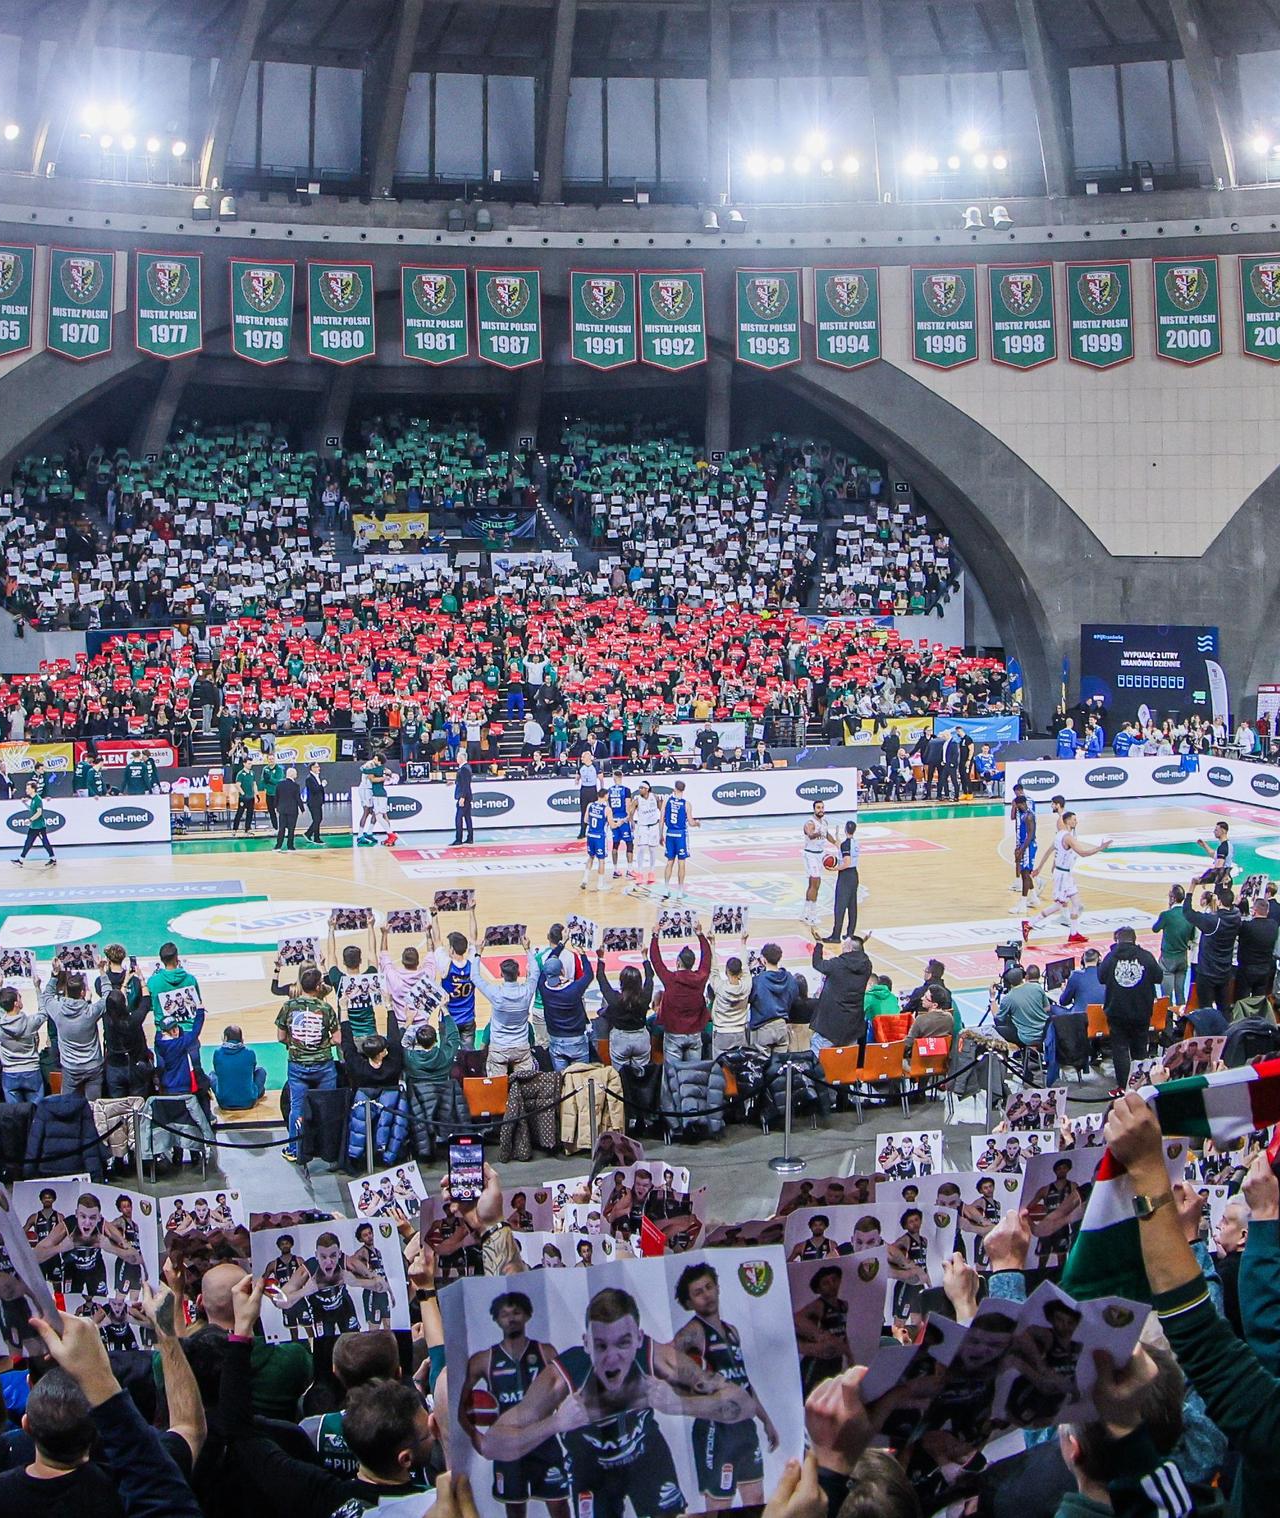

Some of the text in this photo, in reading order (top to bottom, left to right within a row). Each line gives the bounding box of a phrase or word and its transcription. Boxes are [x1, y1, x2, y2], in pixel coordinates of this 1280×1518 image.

[0, 305, 28, 315] POLSKI
[53, 307, 109, 319] MISTRZ POLSKI
[140, 309, 197, 319] MISTRZ POLSKI
[236, 315, 289, 326] MISTRZ POLSK
[313, 316, 371, 325] MISTRZ POLSKI
[1160, 315, 1216, 324] MISTRZ POLSKI
[1247, 313, 1274, 321] MISTRZ
[407, 319, 464, 328] MISTRZ POLSKI
[482, 322, 537, 331] MISTRZ POLSKI
[576, 323, 632, 333] MISTRZ POLSKI
[645, 325, 701, 333] MISTRZ POLSKI
[741, 323, 797, 332] MISTRZ POLSKI
[820, 321, 876, 330] MISTRZ POLSKI
[917, 321, 973, 330] MISTRZ POLSKI
[995, 320, 1051, 330] MISTRZ POLSKI
[1073, 319, 1129, 328] MISTRZ POLSKI
[60, 324, 99, 343] 1970
[150, 325, 187, 343] 1977
[320, 330, 364, 348] 1980
[1167, 329, 1211, 348] 2000
[244, 330, 283, 349] 1979
[415, 333, 455, 350] 1981
[490, 336, 529, 353] 1987
[828, 335, 869, 353] 1994
[924, 335, 966, 353] 1996
[1003, 335, 1044, 353] 1998
[1080, 334, 1122, 352] 1999
[584, 337, 623, 354] 1991
[653, 338, 694, 355] 1992
[748, 337, 789, 354] 1993
[327, 438, 338, 446] C1
[521, 438, 531, 446] C1
[896, 483, 908, 492] C1
[481, 520, 503, 531] plus
[1161, 652, 1179, 660] LITRY
[1153, 660, 1181, 668] DZIENNIE
[343, 742, 352, 750] C2
[47, 757, 64, 768] LOTTO
[1020, 775, 1056, 786] enel-med
[1088, 771, 1124, 782] enel-med
[800, 782, 839, 795] enel-med
[1252, 779, 1279, 792] enel-med
[717, 786, 761, 799] enel-med
[611, 798, 621, 808] 23
[103, 812, 148, 824] enel-med
[591, 818, 597, 829] 0
[450, 982, 472, 998] 30
[529, 1367, 539, 1380] 7
